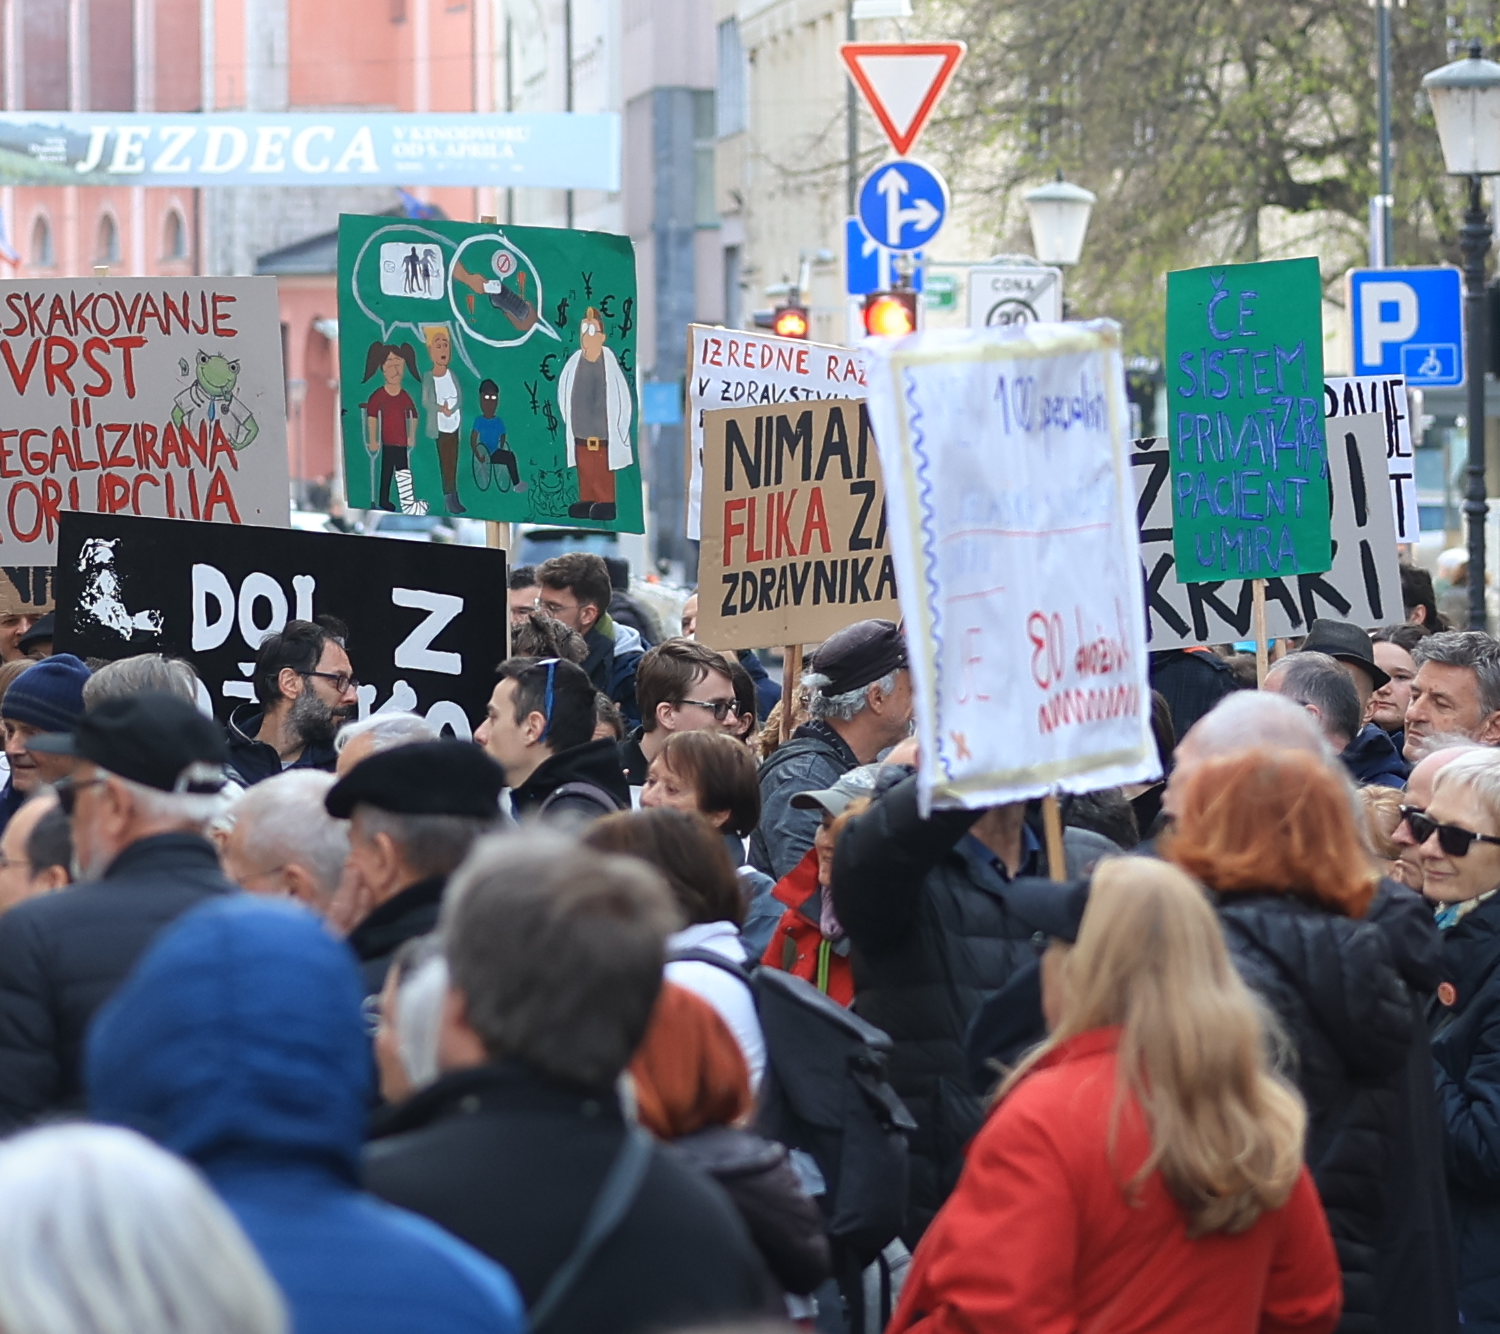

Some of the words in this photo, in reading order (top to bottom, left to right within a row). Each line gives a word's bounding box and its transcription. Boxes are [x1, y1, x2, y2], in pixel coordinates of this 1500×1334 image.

[77, 125, 380, 175] JEZDECA
[1206, 270, 1258, 341] ČE
[0, 336, 149, 399] VRST
[698, 377, 711, 397] V
[702, 338, 810, 375] IZREDNE
[1177, 340, 1308, 401] SISTEM
[1176, 469, 1310, 521] PACIENT
[723, 486, 831, 567] FLIKA
[1195, 523, 1299, 575] UMIRA
[721, 554, 898, 617] ZDRAVNIKA
[391, 588, 464, 675] Z
